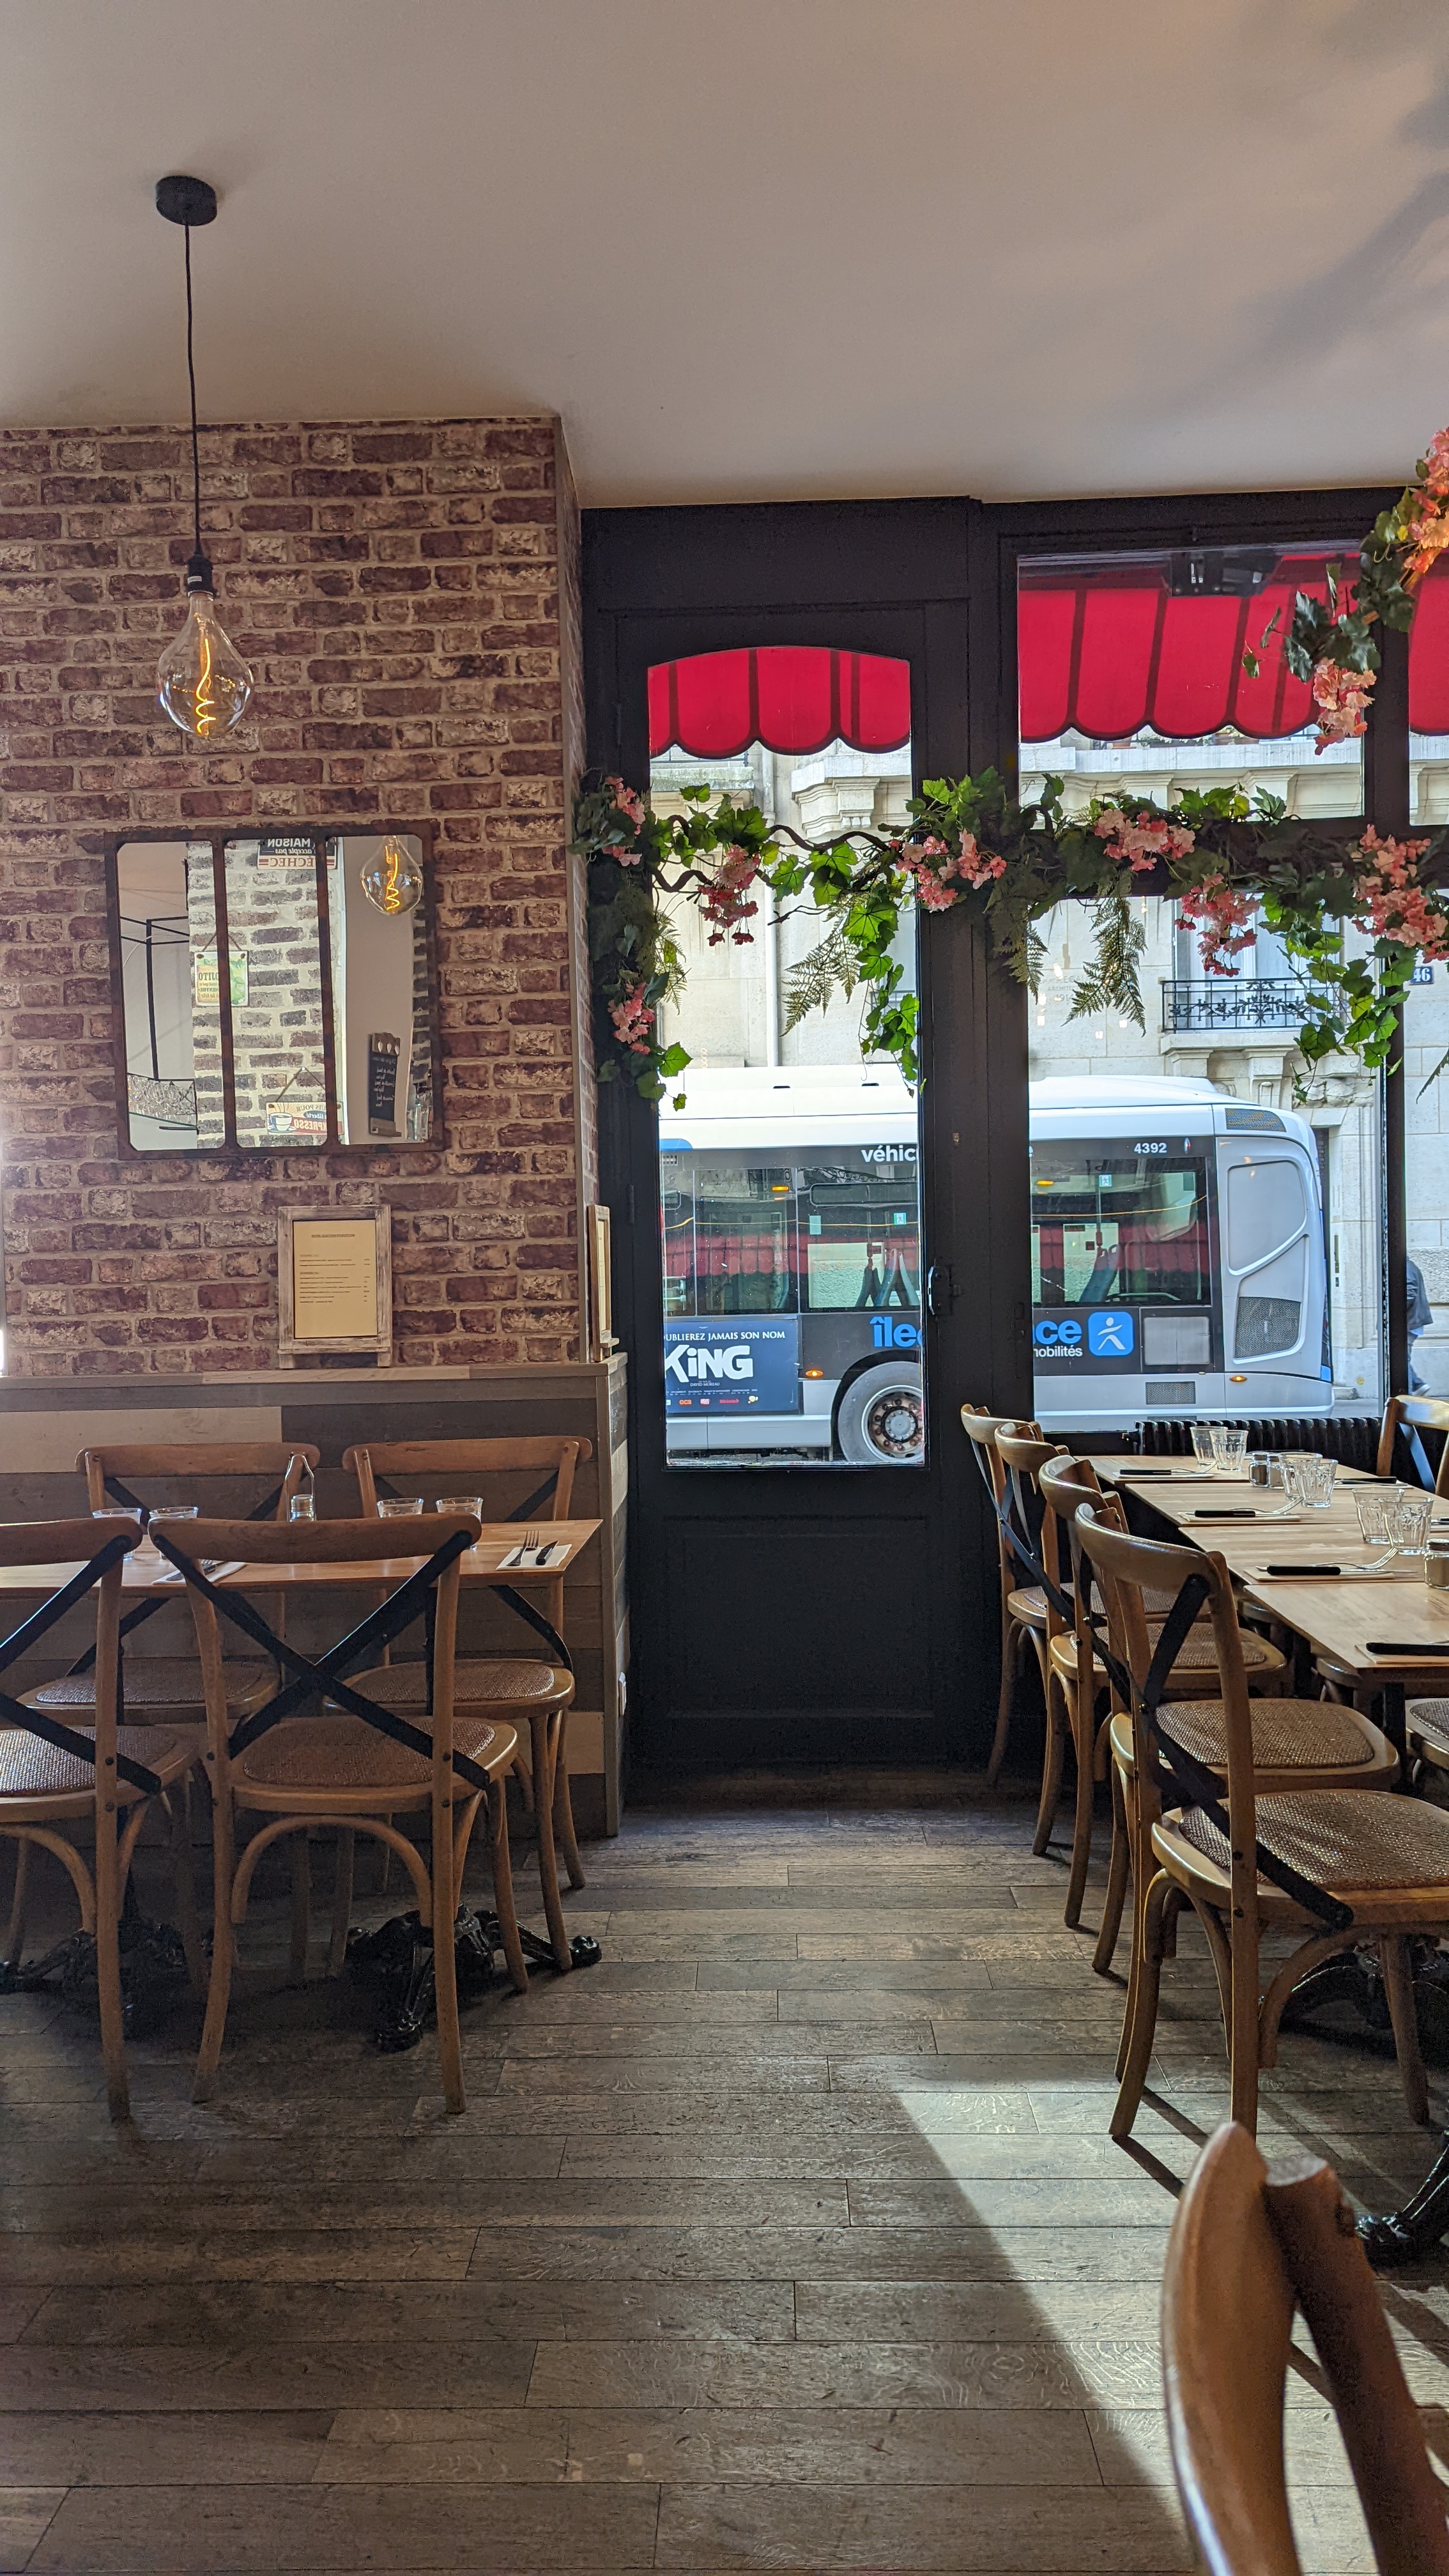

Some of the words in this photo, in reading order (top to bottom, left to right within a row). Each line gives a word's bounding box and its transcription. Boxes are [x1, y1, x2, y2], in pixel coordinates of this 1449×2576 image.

[1413, 968, 1431, 982] 46
[861, 1145, 916, 1162] véhic
[1134, 1142, 1167, 1154] 4392
[708, 1332, 738, 1342] JAMAIS
[762, 1331, 785, 1339] NOM
[1033, 1320, 1082, 1344] ce
